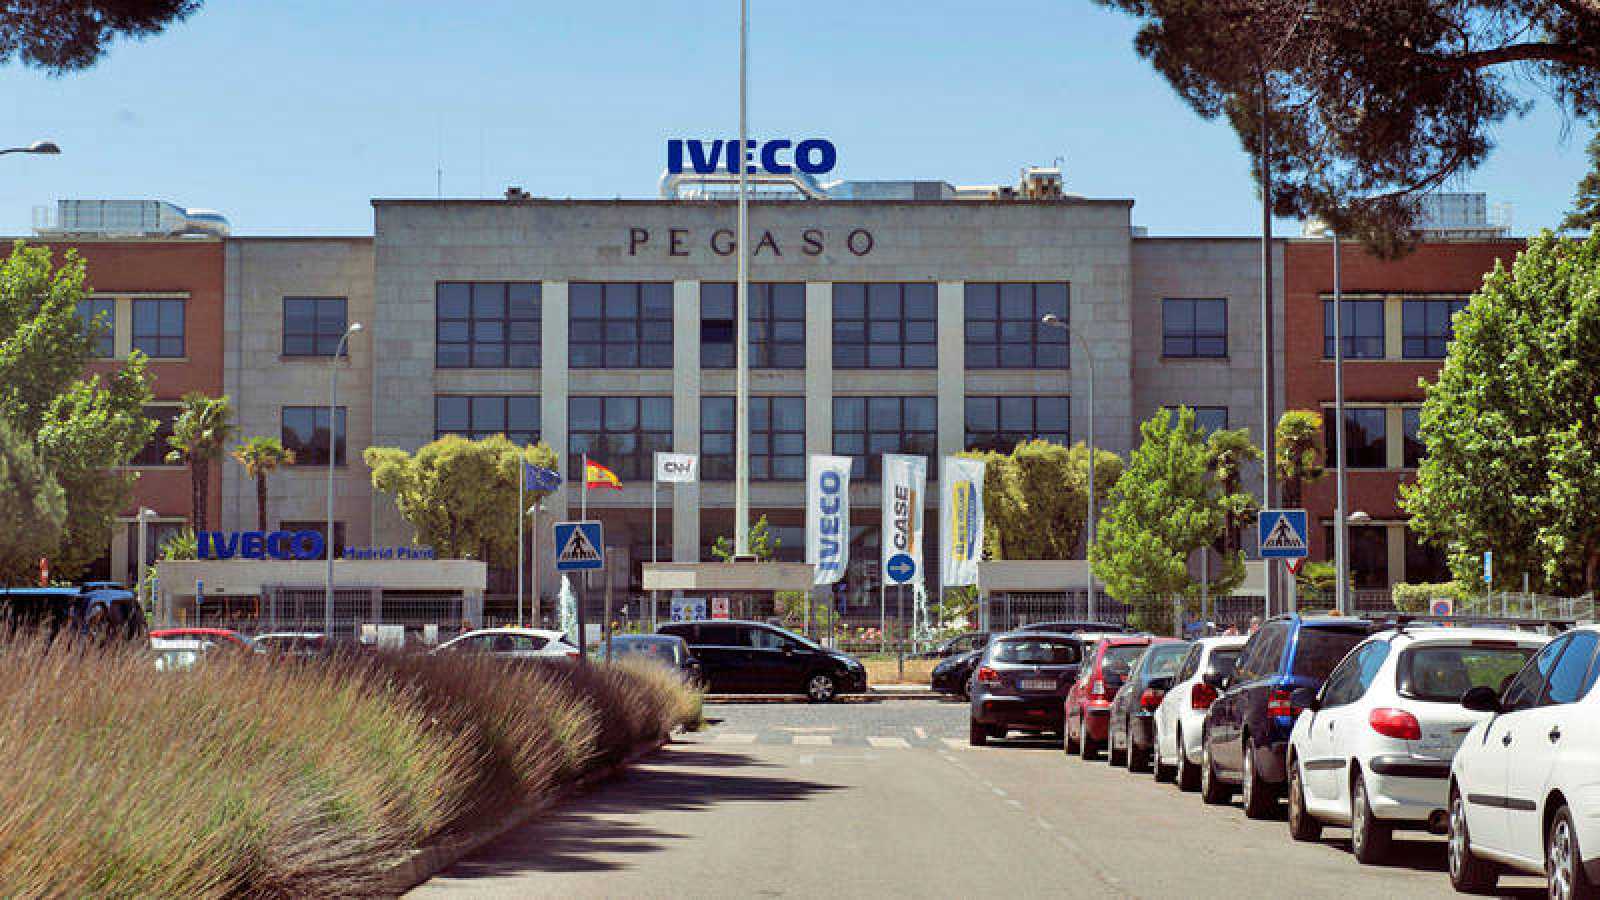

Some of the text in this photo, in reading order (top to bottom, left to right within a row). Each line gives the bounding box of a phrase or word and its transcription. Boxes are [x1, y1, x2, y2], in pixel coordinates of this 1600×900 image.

[667, 139, 837, 175] IVECO
[628, 227, 875, 257] PEGASO
[819, 470, 841, 571] IVECO
[893, 484, 909, 550] CASE
[197, 530, 324, 560] IVECO
[342, 545, 393, 560] Madrid
